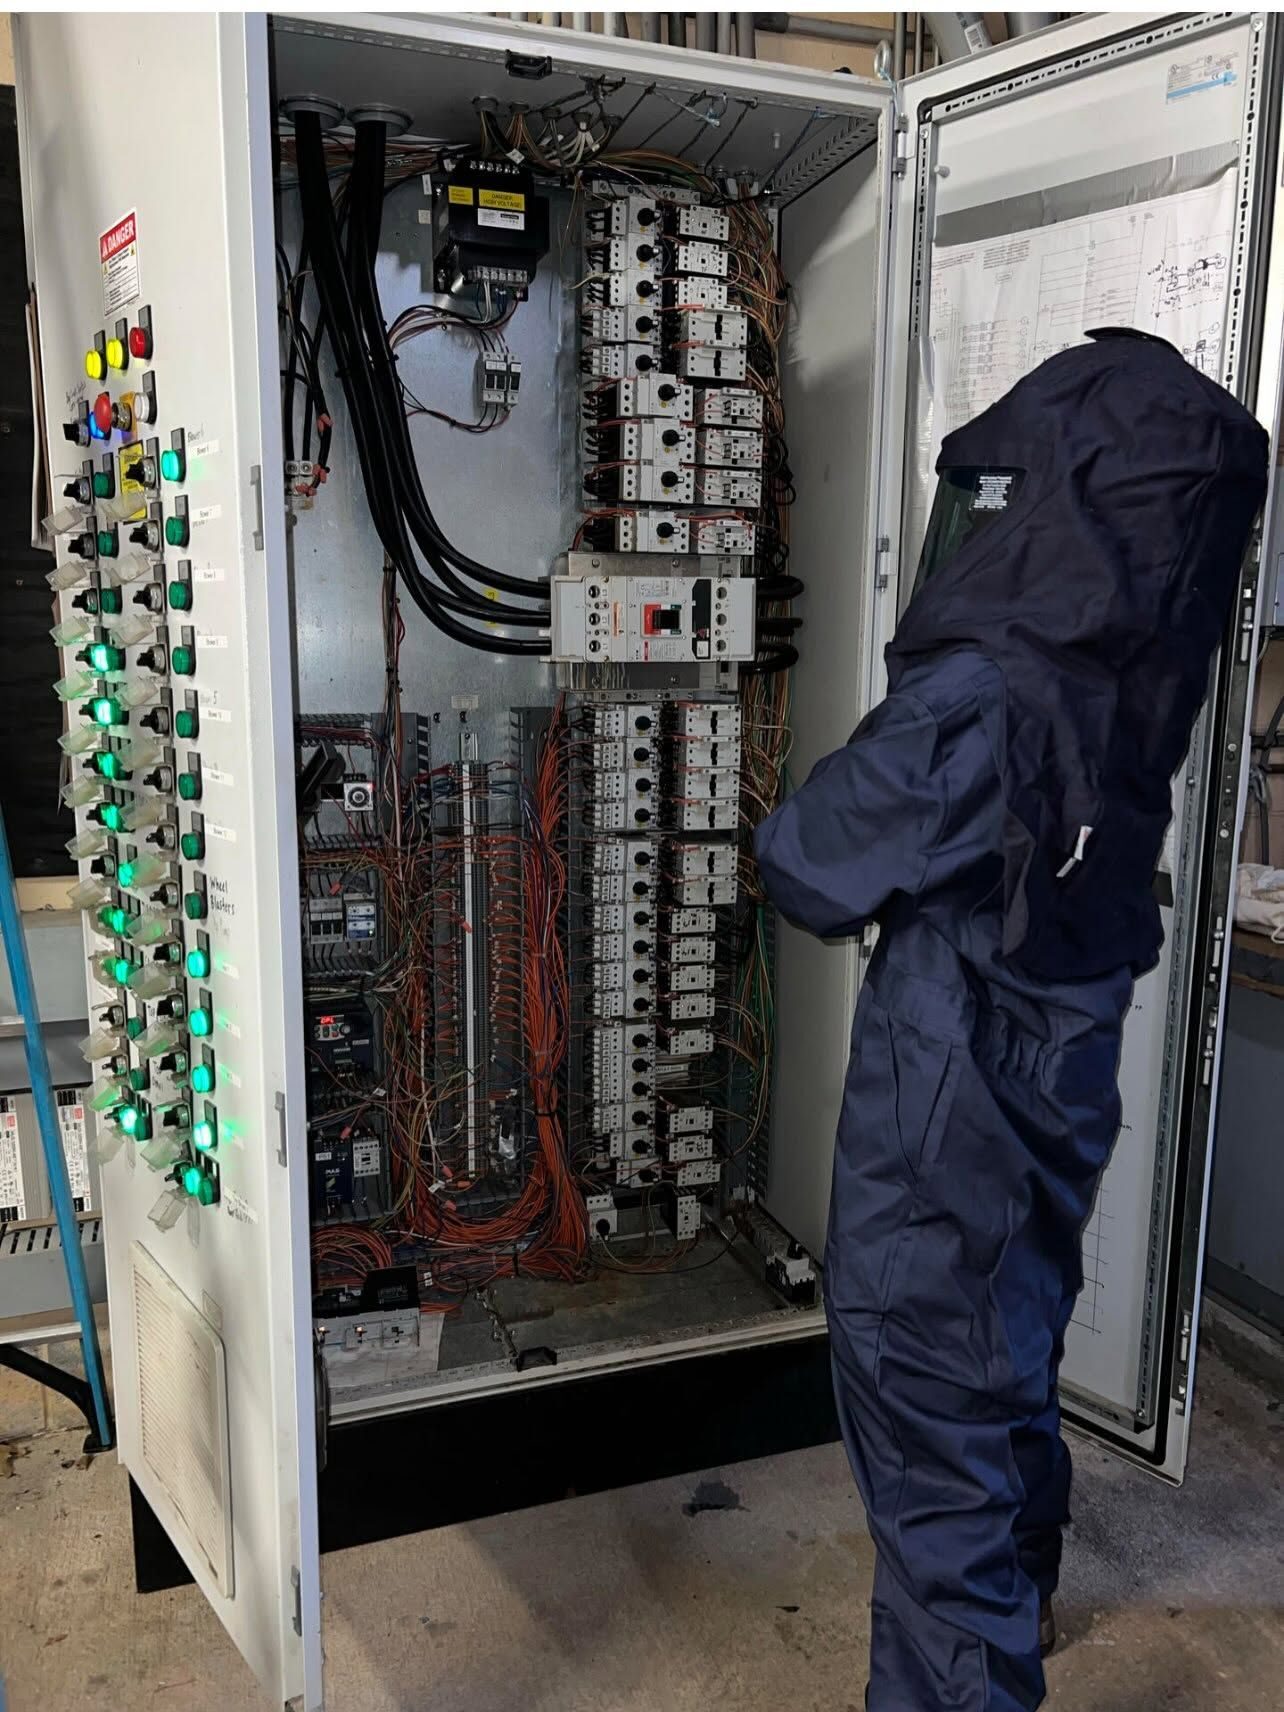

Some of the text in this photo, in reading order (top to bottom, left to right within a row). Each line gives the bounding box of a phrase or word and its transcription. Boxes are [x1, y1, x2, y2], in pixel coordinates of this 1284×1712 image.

[497, 200, 520, 208] VOLTAGE
[107, 220, 134, 250] DANGER
[209, 876, 228, 893] Wheel
[210, 894, 235, 915] Blasters
